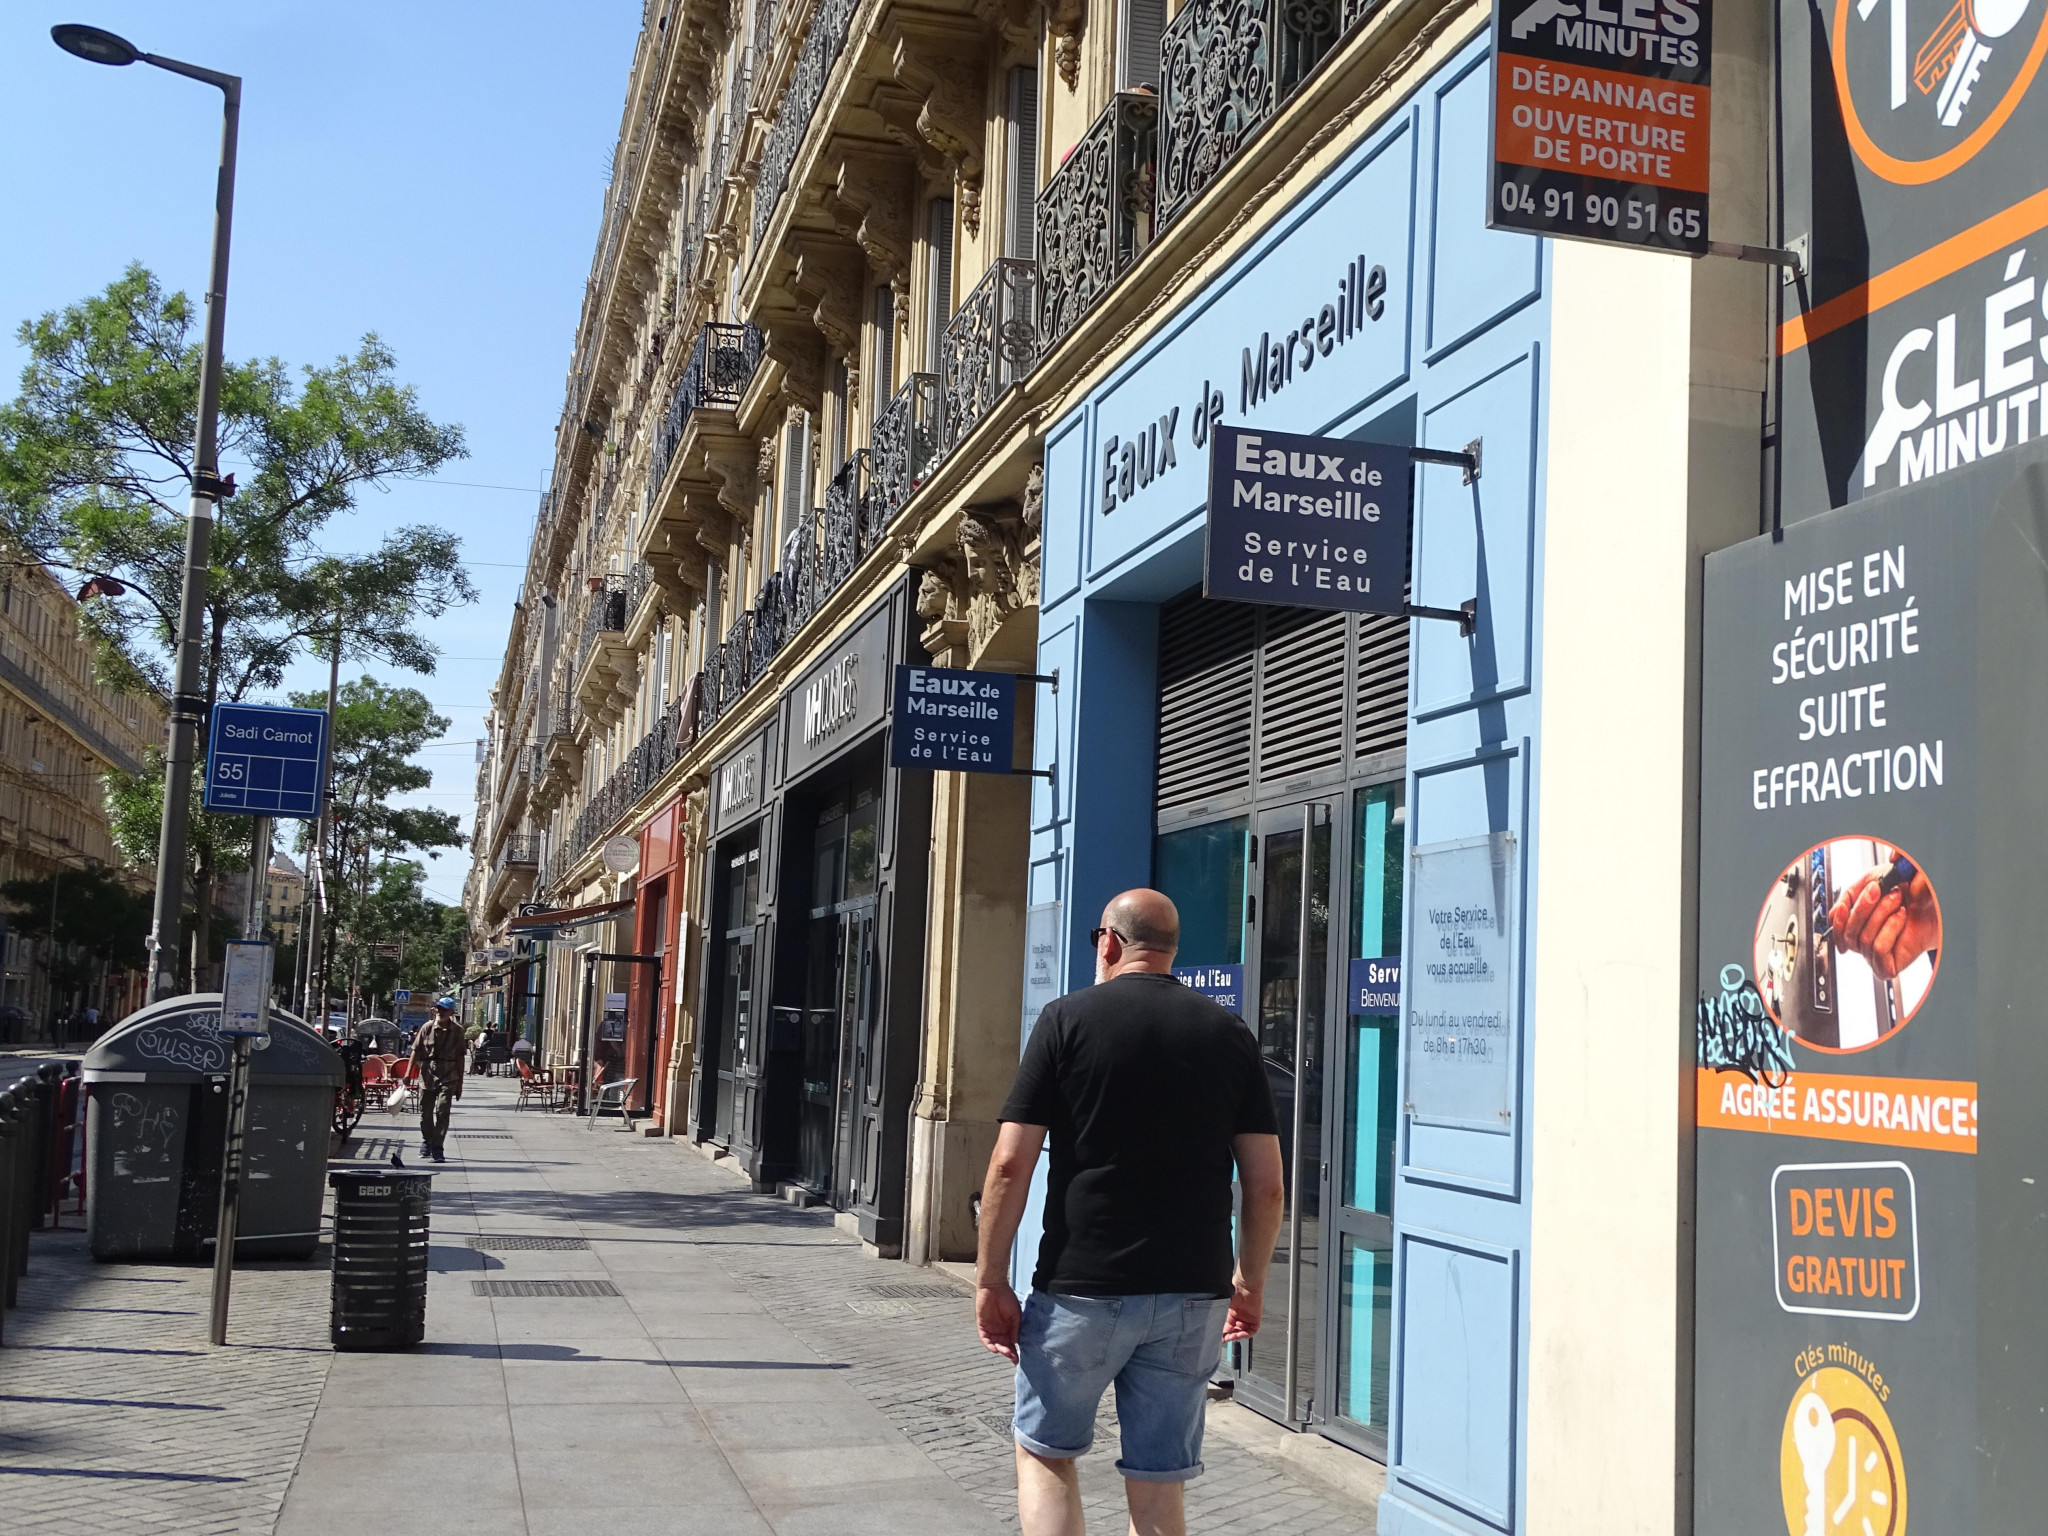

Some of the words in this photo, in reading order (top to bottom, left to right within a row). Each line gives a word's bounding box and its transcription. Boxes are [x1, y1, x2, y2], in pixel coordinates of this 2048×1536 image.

[1556, 18, 1699, 68] MINUTES
[1512, 64, 1696, 119] DÉPANNAGE
[1512, 104, 1686, 153] OUVERTURE
[1534, 135, 1571, 163] DE
[1580, 143, 1672, 179] PORTE
[1501, 181, 1536, 215] 04
[1544, 188, 1574, 221] 91
[1586, 194, 1619, 227] 90
[1627, 200, 1657, 233] 51
[1668, 207, 1701, 239] 65
[1101, 405, 1180, 517] Eaux
[1192, 379, 1224, 449] de
[1240, 253, 1387, 417] Marseille
[1864, 248, 2048, 488] CLÉ
[1900, 380, 2048, 487] MINUT
[1235, 434, 1345, 483] Eaux
[1350, 461, 1383, 488] de
[1233, 479, 1381, 524] Marseille
[1244, 531, 1368, 565] Service
[1239, 559, 1274, 582] de
[1292, 563, 1371, 594] l'Eau
[1784, 560, 1854, 621] MISE
[1863, 544, 1906, 598] EN
[1772, 595, 1920, 685] SÉCURITÉ
[909, 669, 977, 697] Eaux
[980, 683, 1000, 699] de
[907, 696, 999, 720] Marseille
[1798, 682, 1887, 741] SUITE
[224, 724, 259, 740] Sadi
[263, 727, 313, 744] Carnot
[910, 743, 932, 758] de
[942, 745, 992, 762] l'Eau
[914, 727, 990, 746] Service
[218, 762, 244, 780] 55
[1752, 740, 1944, 811] EFFRACTION
[1429, 908, 1452, 925] Votre
[1454, 904, 1488, 923] Service
[1440, 932, 1451, 949] de
[1195, 969, 1206, 987] de
[1208, 968, 1232, 987] l'Eau
[1369, 963, 1399, 984] Serv
[1426, 963, 1446, 975] vous
[1448, 957, 1488, 975] accueille
[1361, 988, 1400, 1007] BIENVENU
[1411, 1011, 1423, 1027] Du
[1425, 1010, 1447, 1027] lundi
[1449, 1016, 1459, 1027] au
[1462, 1010, 1502, 1028] vendredi
[1424, 1036, 1434, 1052] de
[1789, 1186, 1897, 1239] DEVIS
[1786, 1254, 1906, 1300] GRATUIT
[1794, 1344, 1825, 1378] Clés
[1828, 1341, 1891, 1402] minutes
